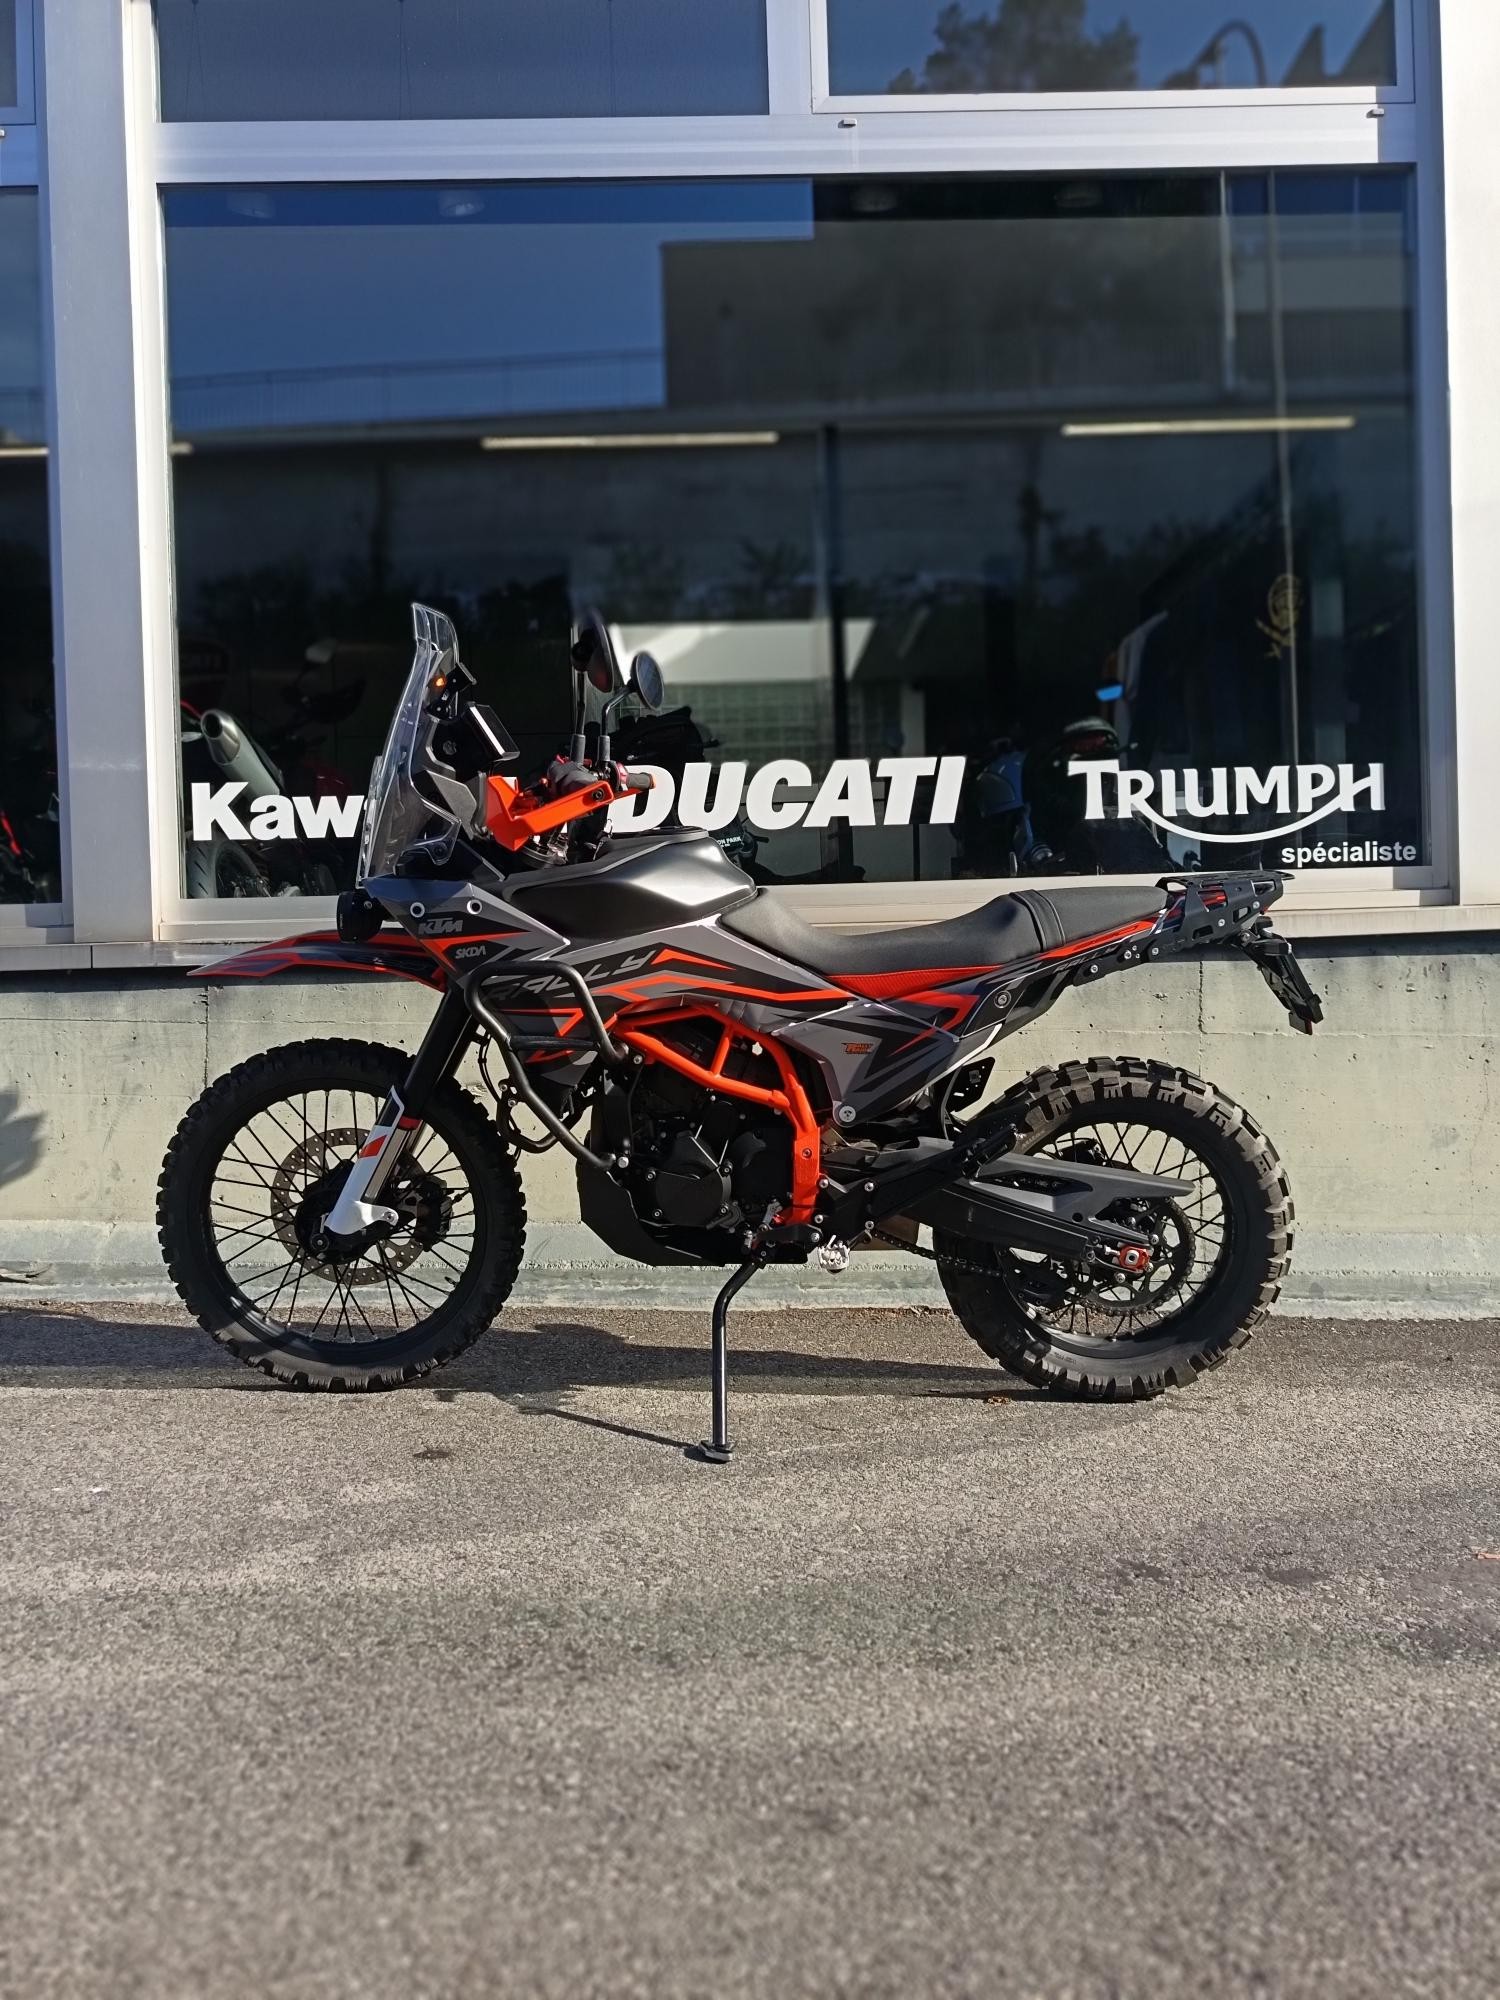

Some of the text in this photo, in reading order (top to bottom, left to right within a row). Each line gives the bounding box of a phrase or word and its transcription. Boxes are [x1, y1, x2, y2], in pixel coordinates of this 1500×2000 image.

[190, 780, 367, 842] Kaw
[604, 756, 967, 832] DUCATI
[1067, 758, 1386, 843] TRIUMPH
[1281, 840, 1417, 868] spécialiste
[418, 917, 464, 935] KTM
